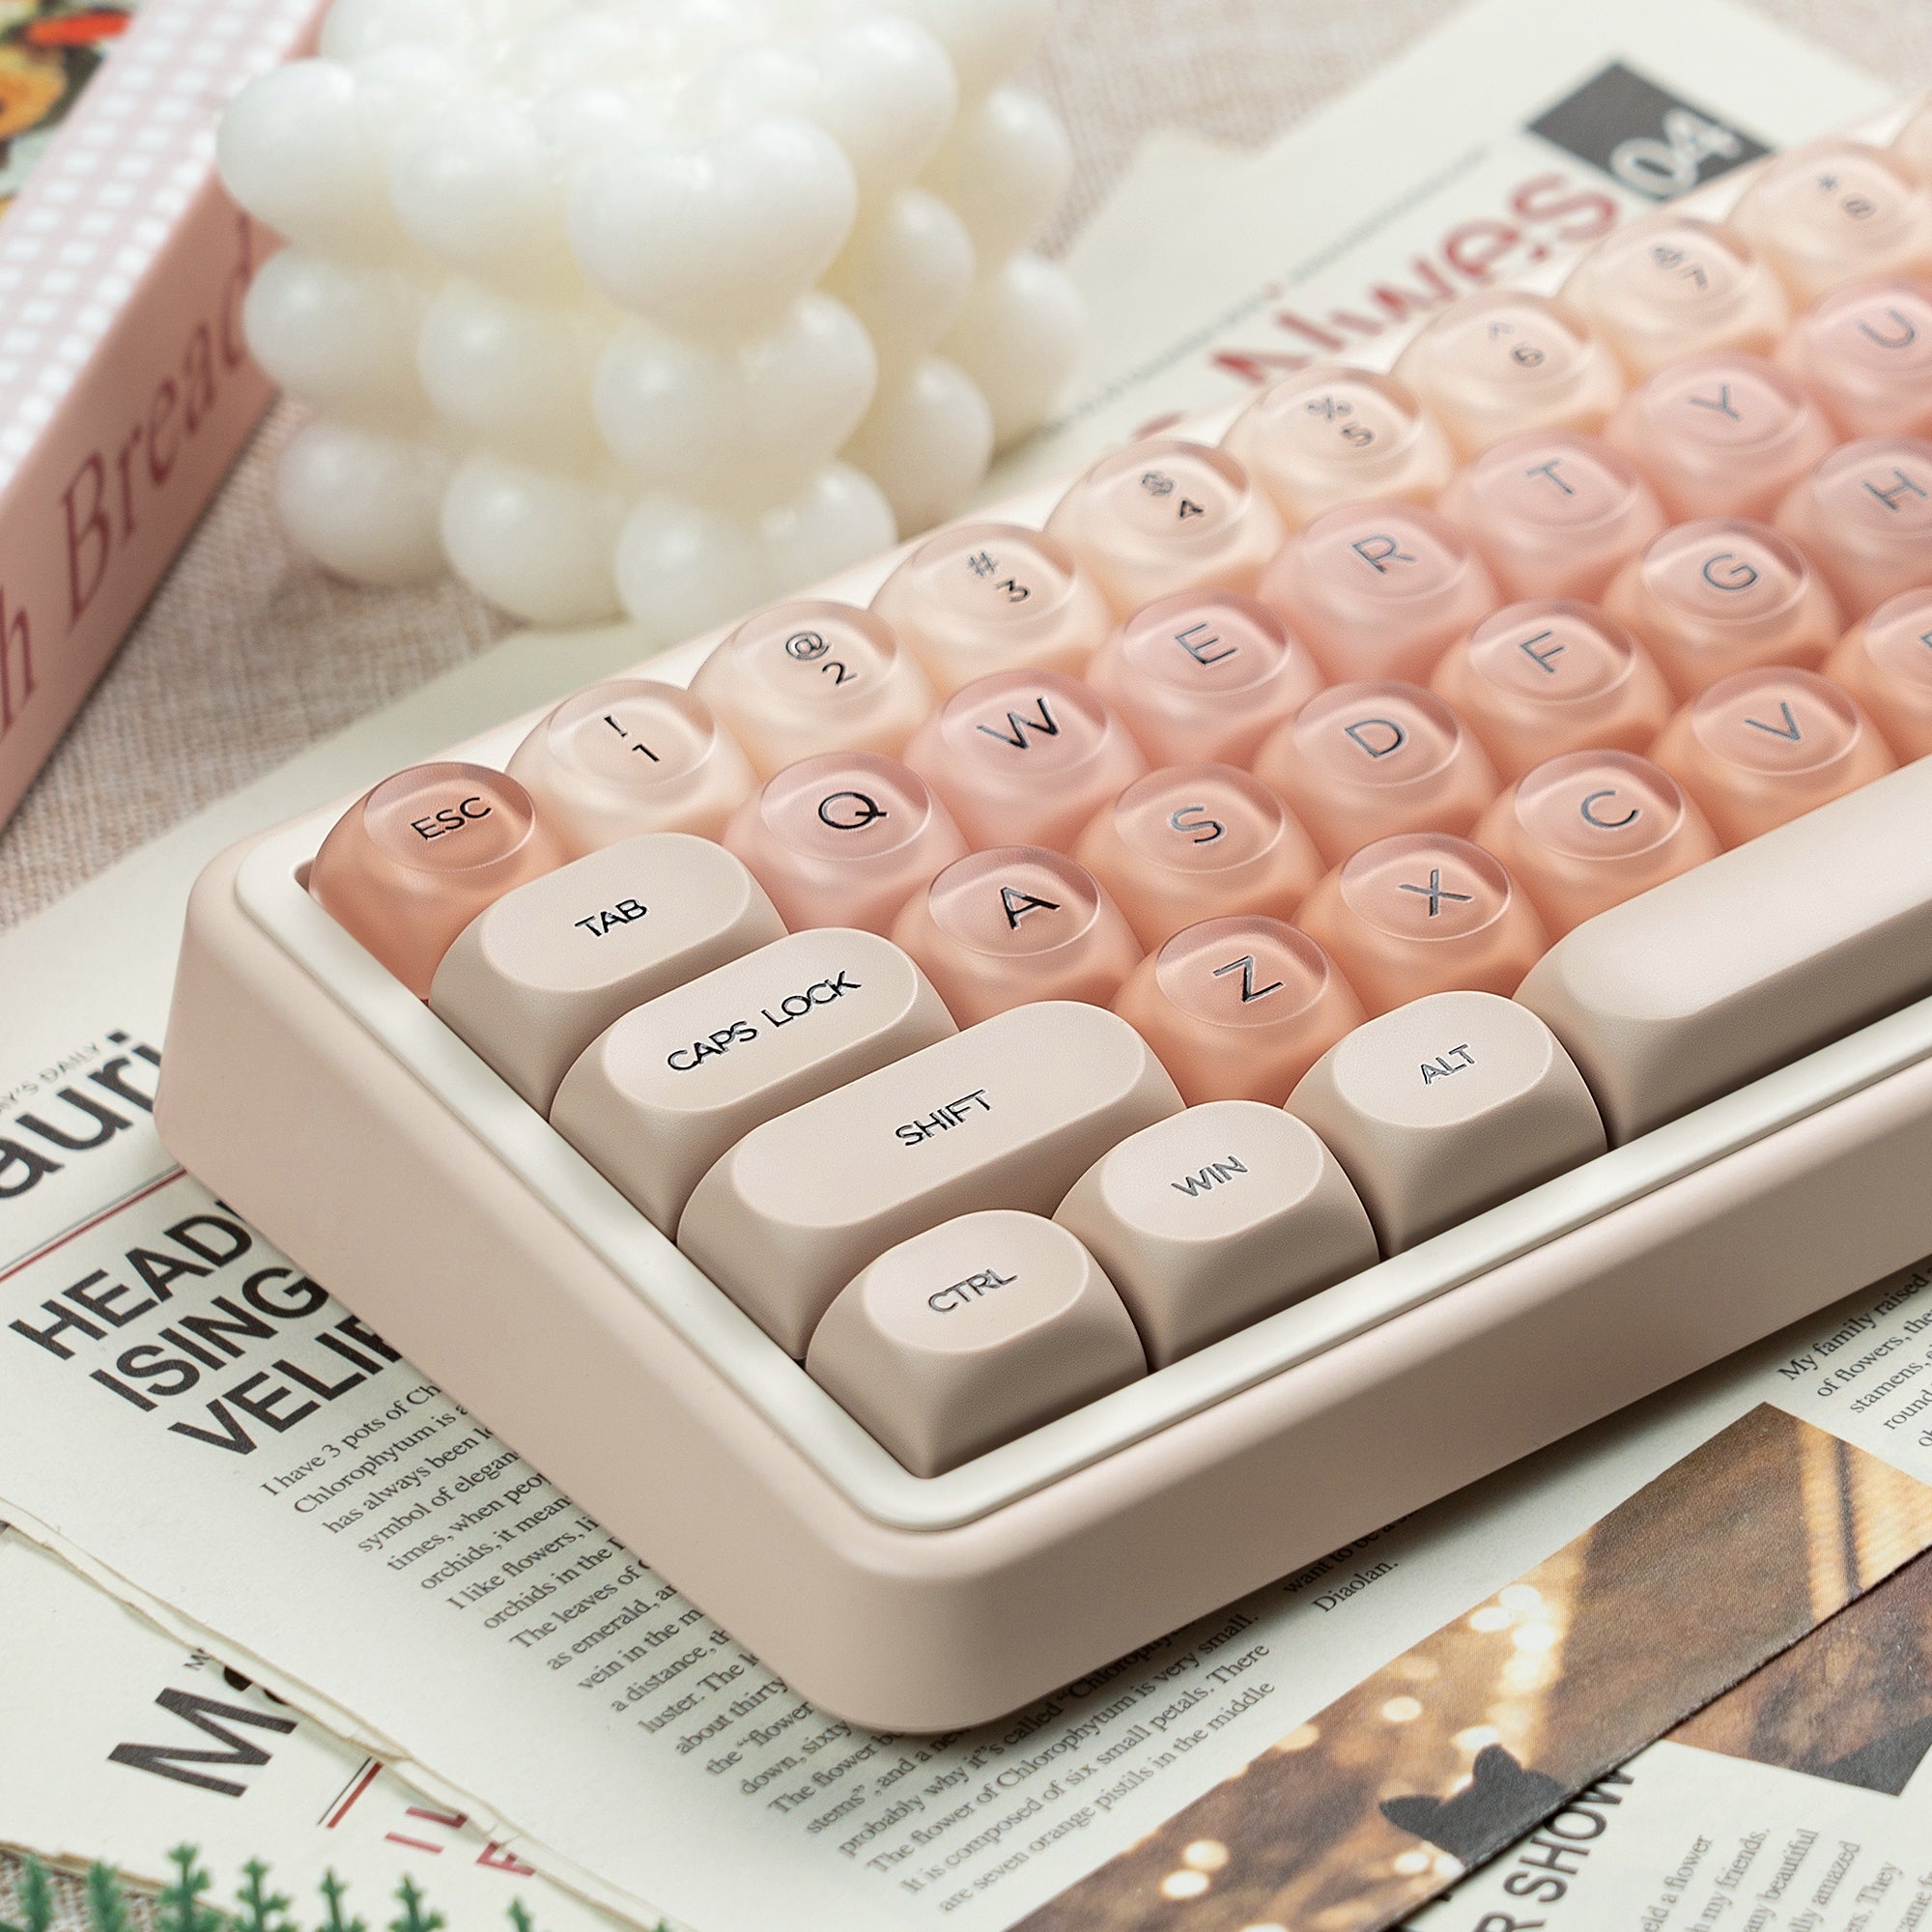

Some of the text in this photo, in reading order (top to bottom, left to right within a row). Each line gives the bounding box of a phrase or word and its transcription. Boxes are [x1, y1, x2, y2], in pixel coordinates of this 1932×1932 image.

[1609, 108, 1743, 199] 04
[1857, 307, 1918, 349] U
[1511, 345, 1544, 368] 6
[1688, 382, 1743, 421] Y
[1341, 421, 1375, 446] 5
[1525, 459, 1575, 495] T
[1861, 467, 1929, 513] H
[1178, 498, 1204, 521] 4
[1351, 534, 1417, 574] R
[1702, 553, 1759, 591] G
[996, 578, 1031, 604] 3
[784, 630, 830, 661] @
[1175, 622, 1236, 667] E
[1520, 630, 1566, 674] F
[821, 661, 858, 685] 2
[976, 696, 1061, 750] W
[1344, 718, 1406, 758] D
[1745, 701, 1803, 742] V
[632, 743, 661, 763] 1
[411, 795, 493, 841] ESC
[817, 790, 890, 830] Q
[1169, 805, 1224, 845] S
[1579, 788, 1640, 829] C
[999, 886, 1061, 931] A
[1397, 867, 1473, 919] X
[574, 897, 648, 938] TAB
[1212, 953, 1284, 1004] Z
[667, 969, 863, 1071] CAPS LOCK
[39, 1040, 101, 1084] DAILY
[1419, 1042, 1476, 1086] ALT
[894, 1088, 993, 1148] SHIFT
[1170, 1154, 1249, 1199] WIN
[9, 1200, 253, 1360] HEAD
[927, 1267, 1018, 1314] CTRL
[1777, 1354, 1818, 1379] My
[1812, 1314, 1876, 1355] family
[1874, 1273, 1929, 1316] raised
[1817, 1378, 1839, 1396] of
[1834, 1337, 1911, 1381] flowers,
[1904, 1310, 1932, 1333] the
[1850, 1363, 1930, 1412] stamens,
[273, 1457, 326, 1488] have
[322, 1444, 340, 1458] 3
[341, 1419, 385, 1449] pots
[385, 1400, 409, 1419] of
[407, 1380, 442, 1405] Ch
[295, 1413, 456, 1512] Chlorophytum is
[322, 1438, 478, 1533] has always been
[358, 1451, 520, 1551] symbol of elegan
[387, 1535, 454, 1570] times,
[449, 1500, 505, 1531] when
[421, 1496, 572, 1589] orchids, it mean
[460, 1576, 505, 1601] like
[502, 1533, 584, 1577] flowers,
[484, 1583, 556, 1628] orchids
[551, 1569, 581, 1584] in
[577, 1548, 612, 1570] the
[1283, 1558, 1333, 1592] want
[1312, 1563, 1397, 1611] Diaolan.
[509, 1565, 641, 1647] The leaves of
[547, 1600, 659, 1670] as emerald,
[578, 1625, 679, 1688] vein in the
[611, 1700, 629, 1712] a
[627, 1647, 716, 1701] distance,
[638, 1665, 744, 1733] luster. The
[676, 1715, 733, 1754] about
[867, 1845, 914, 1872] The
[911, 1802, 975, 1844] flower
[977, 1783, 999, 1803] of
[997, 1696, 1136, 1787] Chlorophytum
[1128, 1683, 1155, 1696] is
[1152, 1653, 1200, 1681] very
[1199, 1614, 1258, 1654] small.
[706, 1751, 742, 1774] the
[742, 1757, 806, 1794] down,
[768, 1744, 877, 1812] The flower
[839, 1796, 924, 1857] probably
[923, 1767, 969, 1795] why
[1001, 1697, 1064, 1745] called
[877, 1757, 917, 1787] and
[915, 1745, 932, 1762] a
[900, 1646, 1269, 1893] It is composed of six small petals. There
[940, 1684, 1274, 1912] are seven orange pistils in the middle
[1502, 1768, 1635, 1903] SHOW
[1714, 1828, 1771, 1890] friends.
[1662, 1833, 1715, 1891] flower
[1755, 1828, 1821, 1903] beautiful
[1810, 1839, 1862, 1907] amazed
[1854, 1860, 1904, 1905] They
